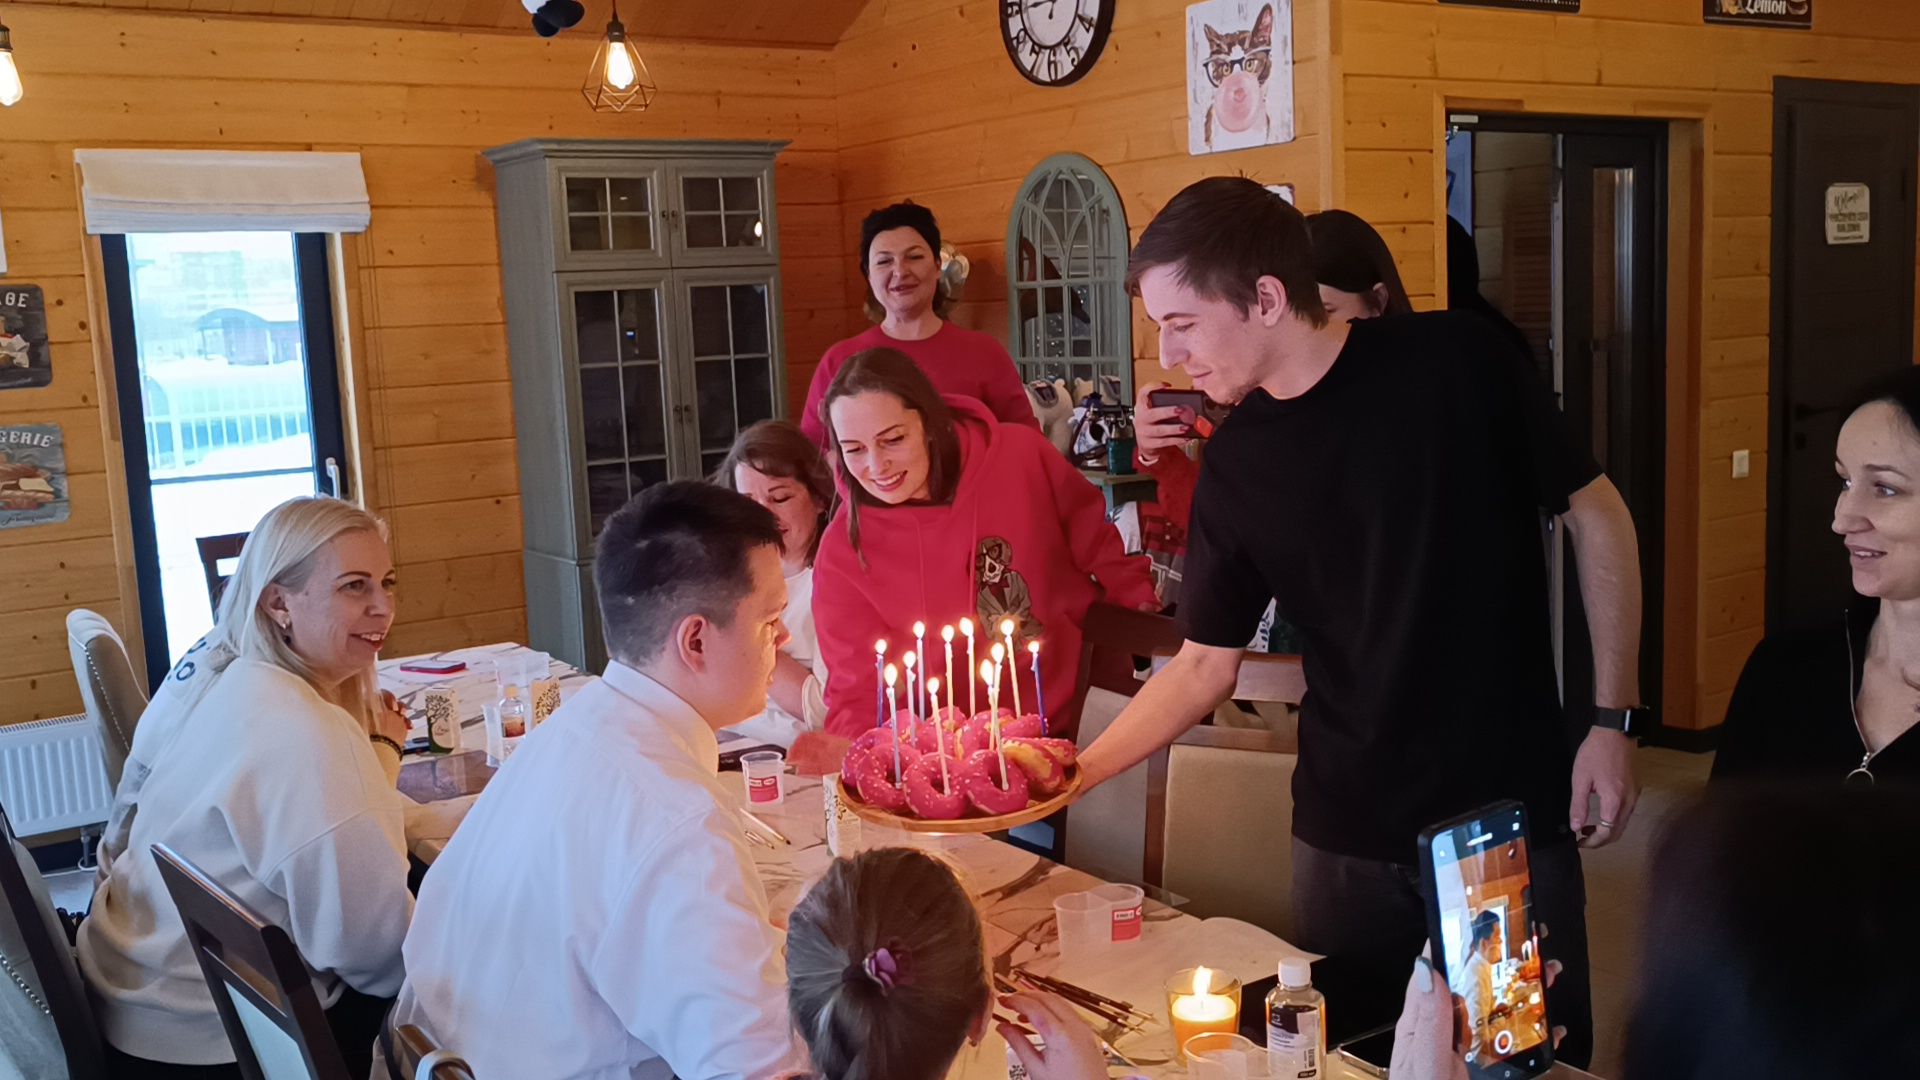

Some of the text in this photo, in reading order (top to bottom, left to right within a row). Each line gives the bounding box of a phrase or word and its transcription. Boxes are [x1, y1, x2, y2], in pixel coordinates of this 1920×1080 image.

[1077, 13, 1096, 34] 4
[1029, 42, 1041, 75] 7
[1047, 47, 1058, 81] 6
[1062, 36, 1080, 67] 5
